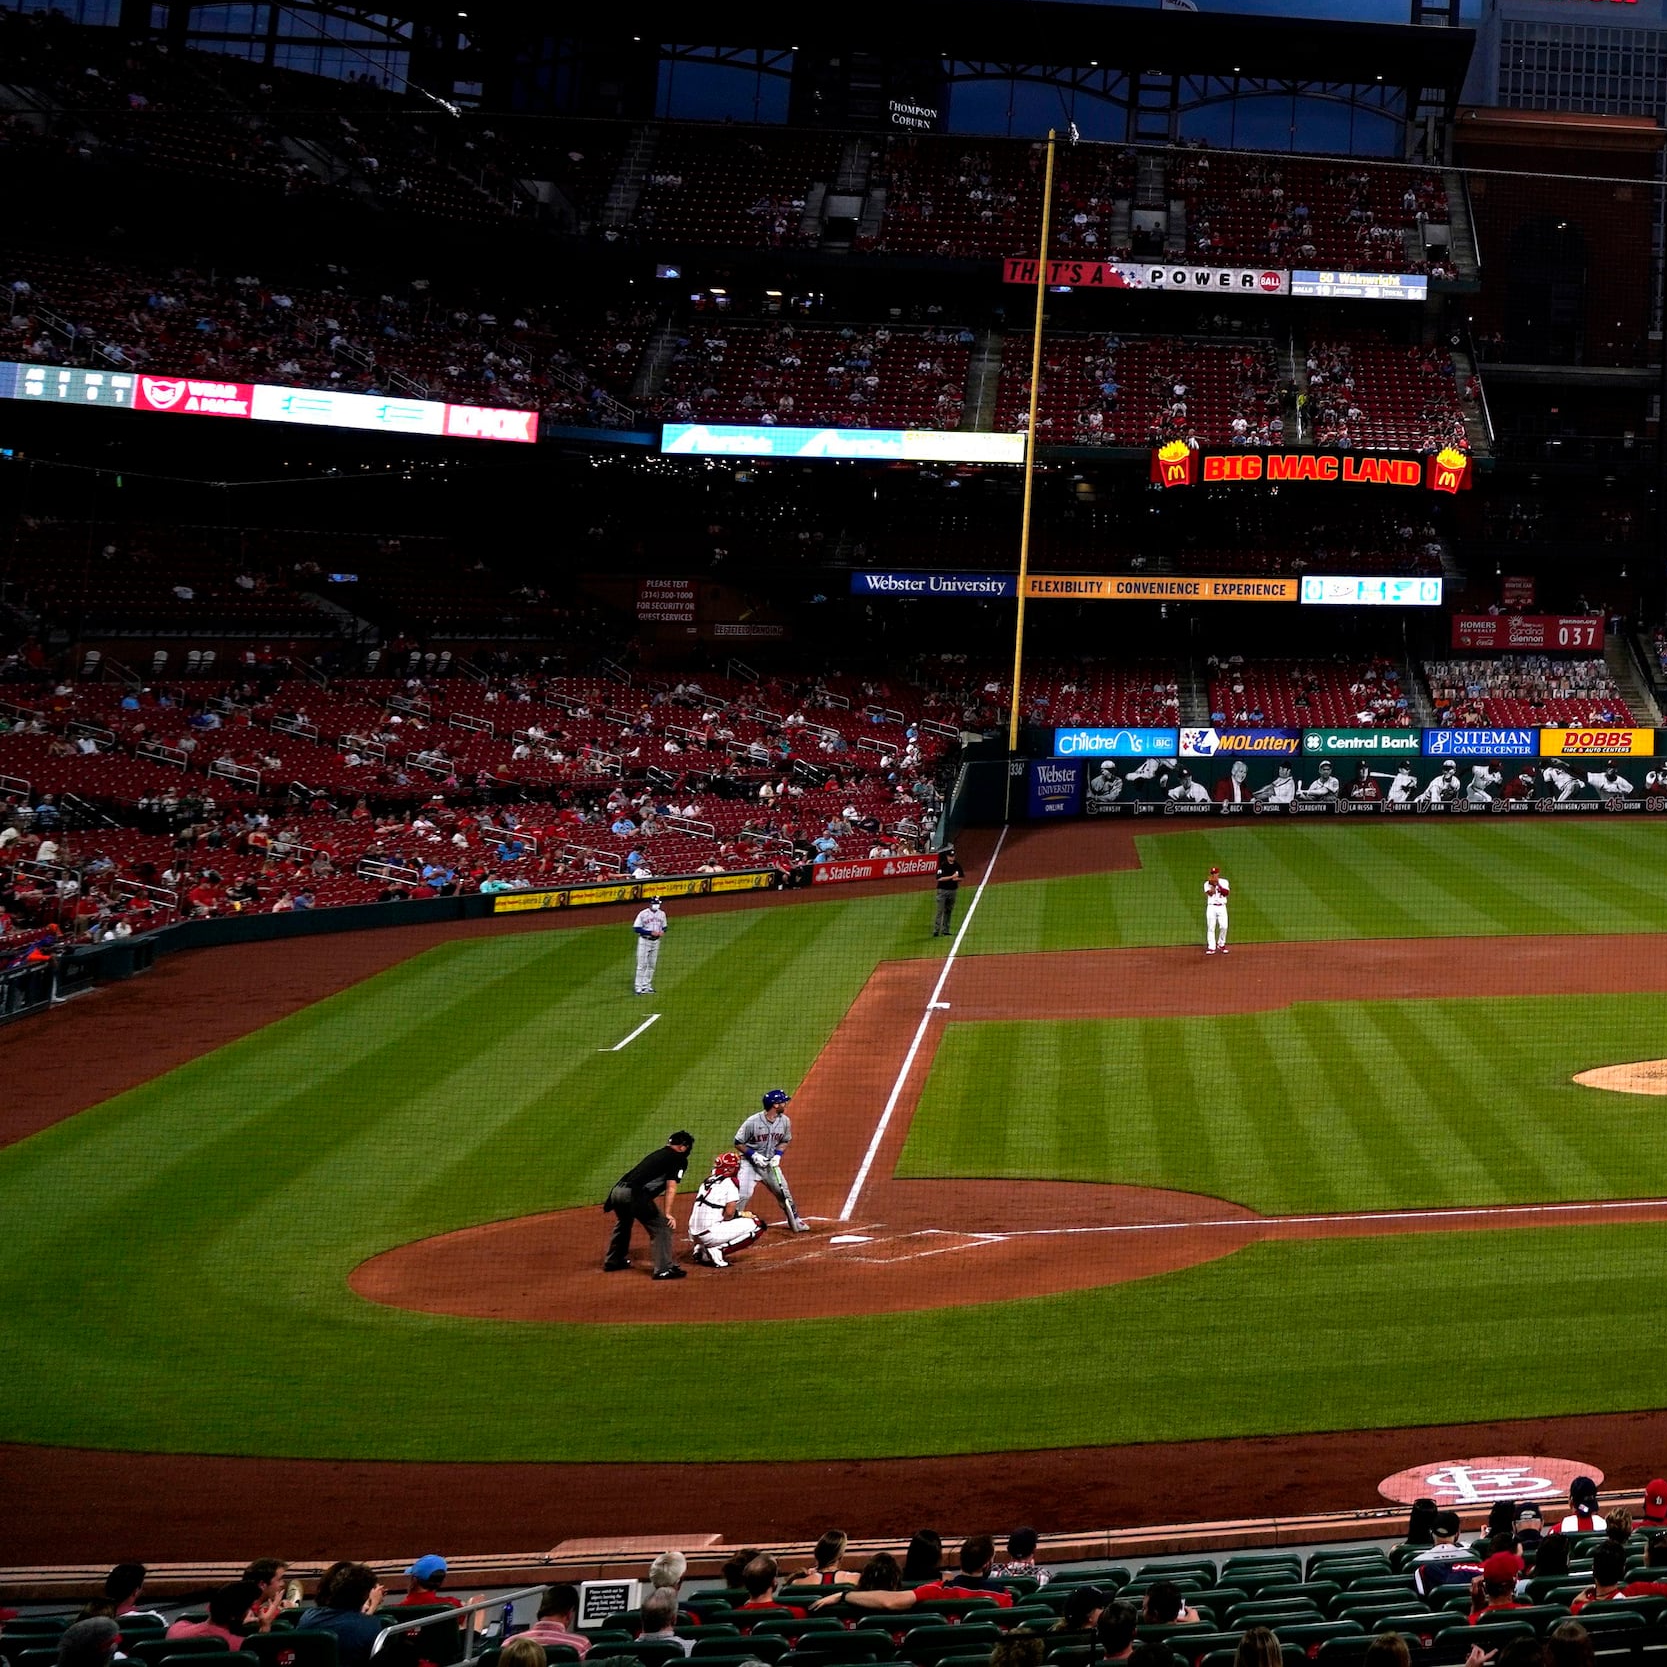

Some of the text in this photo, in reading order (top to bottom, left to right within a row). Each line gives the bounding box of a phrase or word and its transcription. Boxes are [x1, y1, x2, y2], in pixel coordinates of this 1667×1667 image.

[891, 113, 931, 129] COBURN
[1151, 269, 1281, 288] POWER BALL
[1203, 454, 1421, 486] BIG MAC LAND
[646, 580, 689, 589] PLEASE TEXT
[865, 575, 1287, 598] Webster University FLEXIBILITY CONVENIENCE EXPERIENCE
[636, 602, 695, 611] FOR SECURITY OR
[638, 613, 693, 622] GUEST SERVICES
[1460, 621, 1497, 629] HOMERS
[1508, 634, 1545, 643] Glennon
[1218, 734, 1299, 754] MOLottery
[1327, 735, 1419, 749] Central Bank
[1453, 731, 1532, 745] SITEMAN
[1564, 732, 1633, 747] DOBBS
[1453, 746, 1532, 754] CANCER CENTER
[1037, 765, 1077, 782] Webster
[1037, 784, 1075, 796] UNIVERSITY
